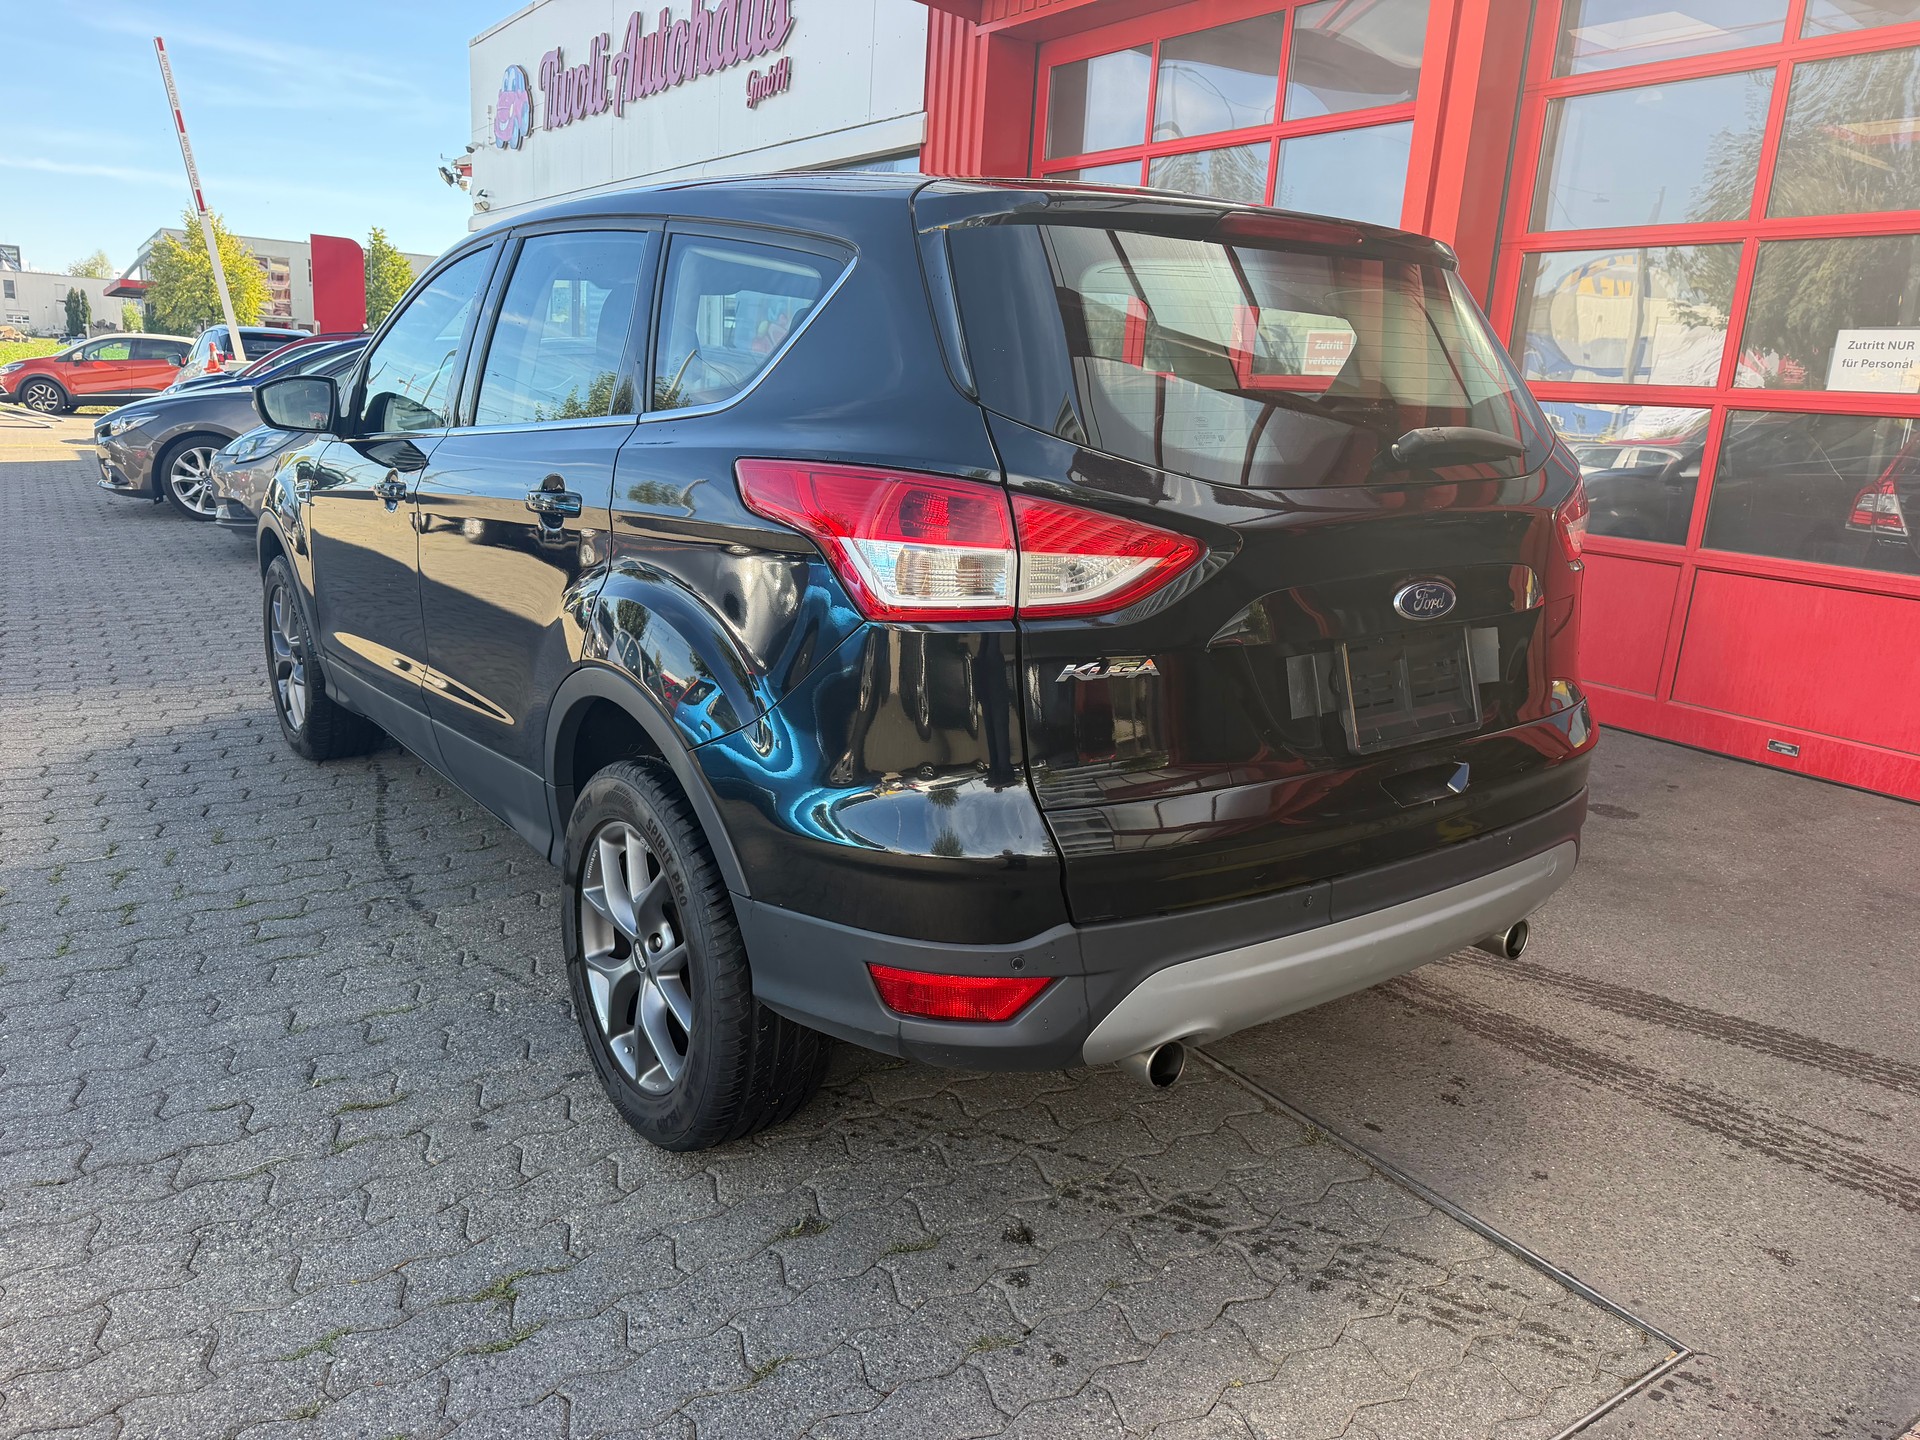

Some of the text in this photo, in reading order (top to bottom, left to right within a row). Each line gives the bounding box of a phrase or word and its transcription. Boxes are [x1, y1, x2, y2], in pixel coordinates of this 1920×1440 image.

[538, 0, 794, 131] Tivoli Autohaus
[746, 56, 790, 109] GmbH
[1314, 340, 1344, 350] Zutritt
[1847, 340, 1915, 350] Zutritt NUR
[1842, 358, 1913, 369] für Personal
[1413, 588, 1446, 611] Ford
[1055, 658, 1160, 682] KUGA
[645, 818, 674, 864] SPIRIT
[671, 871, 688, 907] PRO
